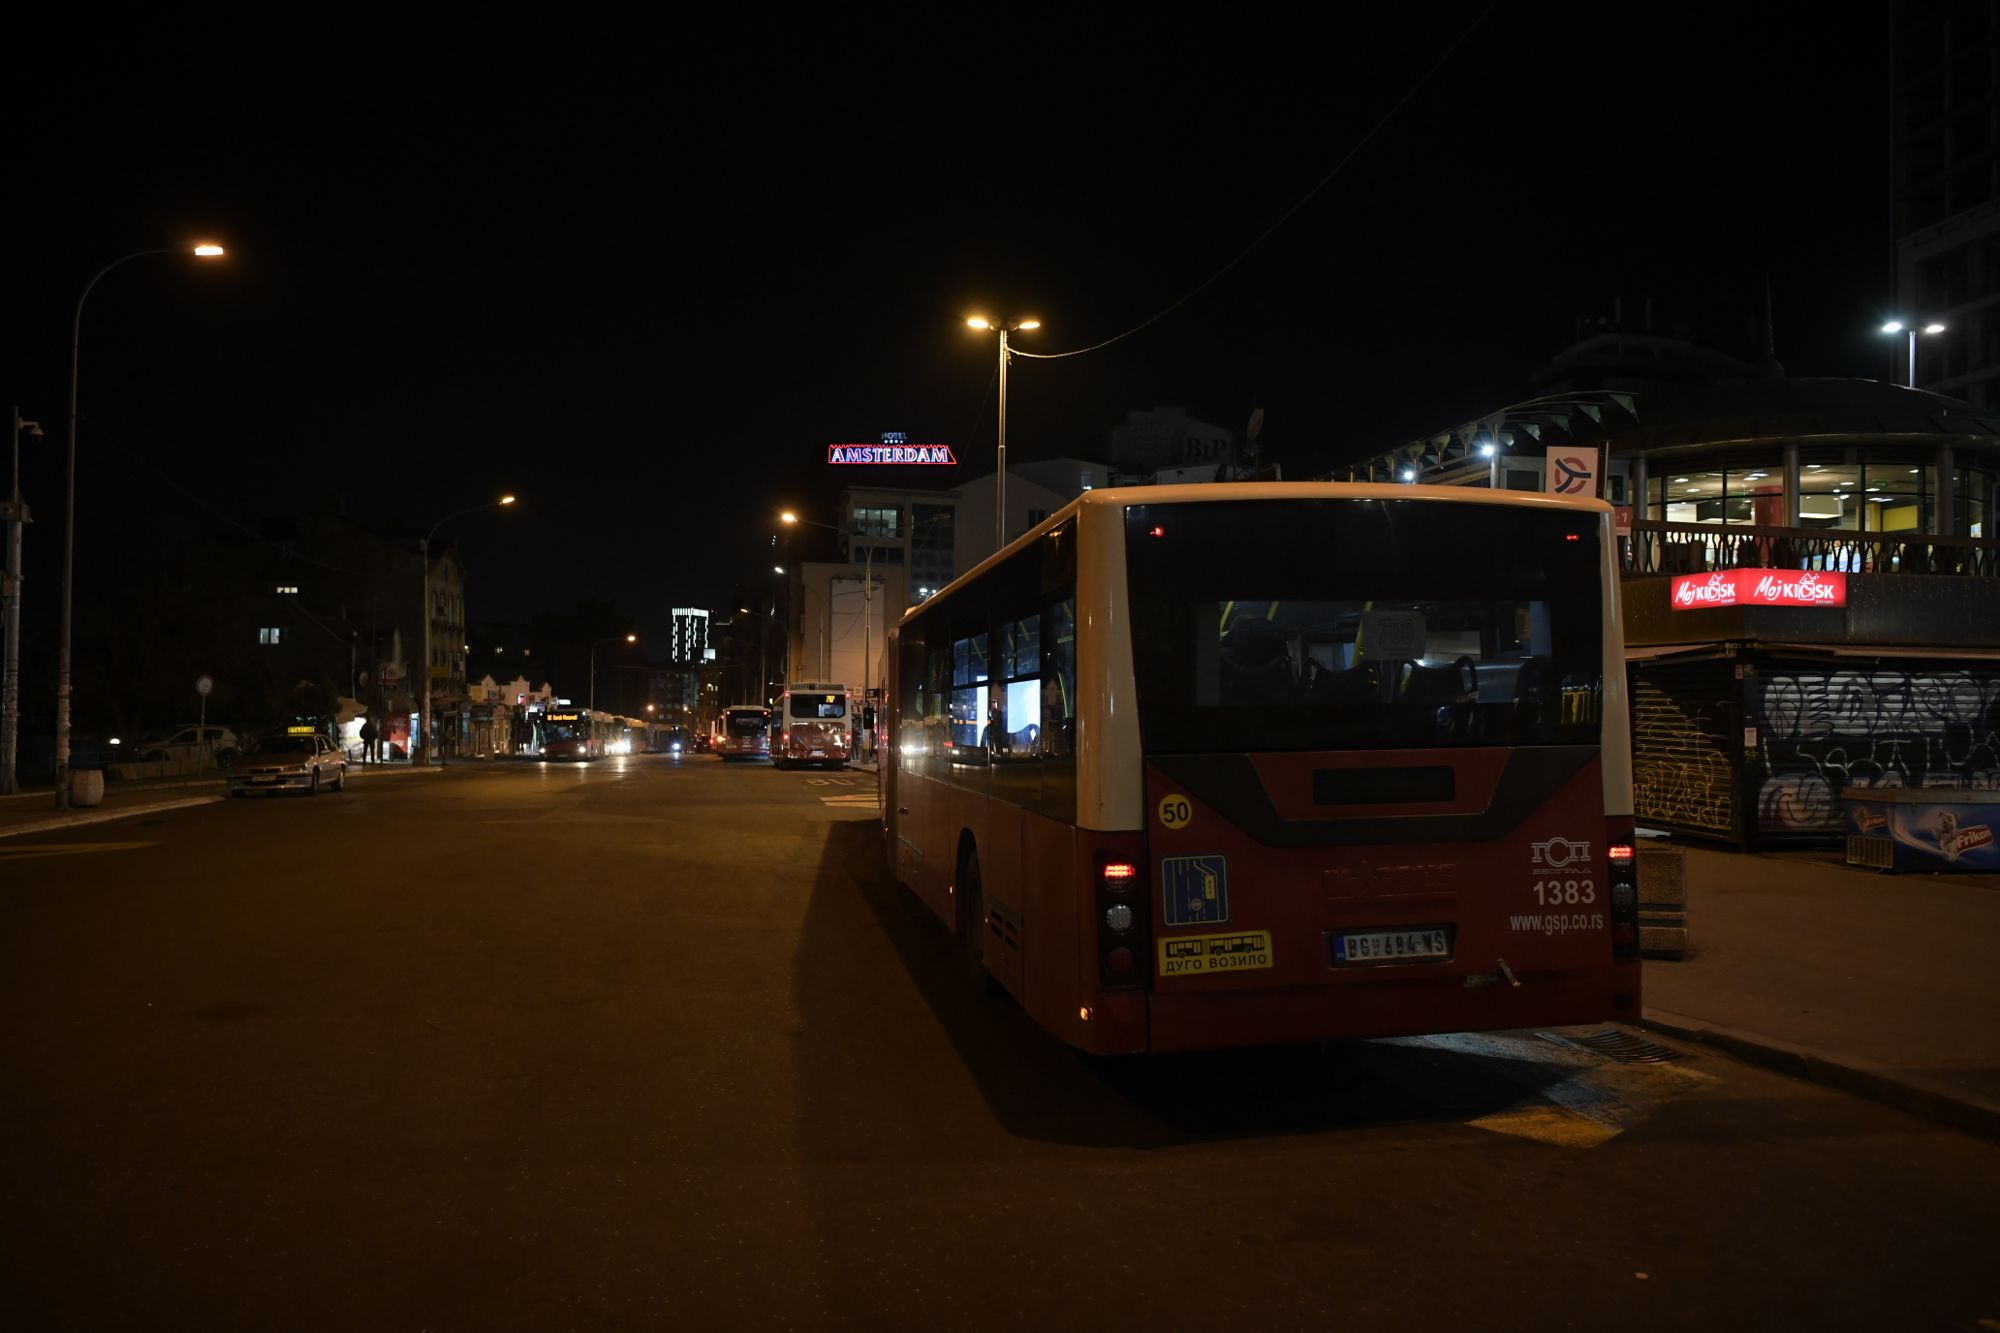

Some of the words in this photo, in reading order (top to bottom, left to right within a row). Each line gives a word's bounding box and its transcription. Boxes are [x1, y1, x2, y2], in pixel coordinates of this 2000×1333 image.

[881, 432, 908, 440] HOTEL
[831, 447, 948, 462] AMSTERDAM
[1675, 581, 1696, 605] Moj
[1696, 582, 1736, 601] KIOSK
[1753, 576, 1783, 601] Moj
[1783, 582, 1834, 601] KIOSK
[1164, 802, 1189, 823] 50
[1956, 830, 1992, 849] Frikom
[1533, 879, 1597, 906] 1383
[1510, 913, 1605, 936] www.gsp.co.rs
[1348, 937, 1370, 957] BG
[1166, 959, 1203, 973] ДУГО
[1209, 953, 1267, 969] ВОЗИЛО
